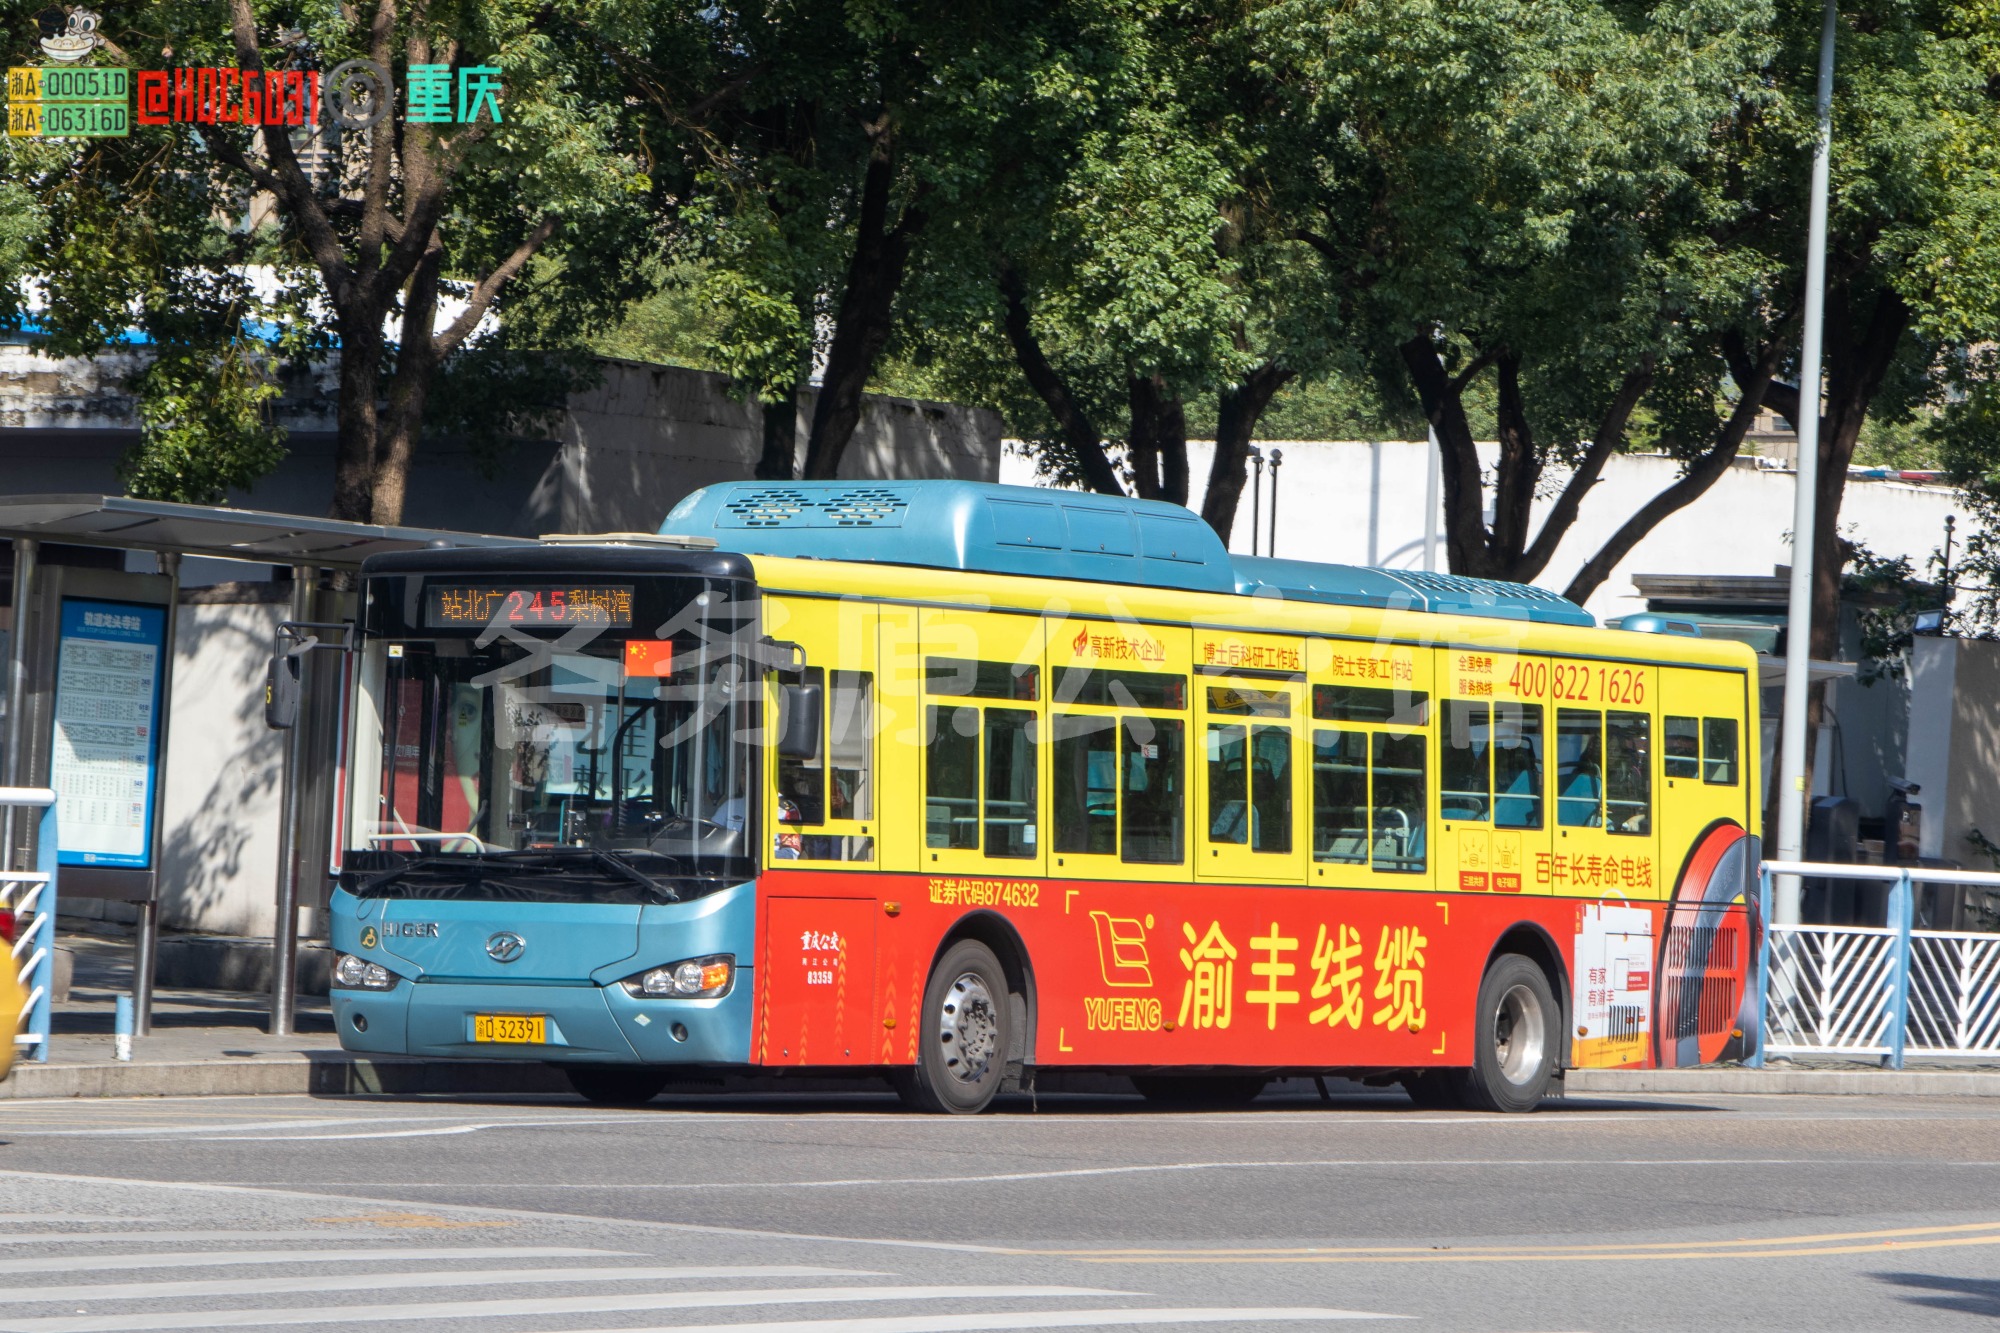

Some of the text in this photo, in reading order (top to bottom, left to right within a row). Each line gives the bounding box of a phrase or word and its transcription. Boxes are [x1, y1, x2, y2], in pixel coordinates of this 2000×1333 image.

[442, 589, 632, 622] 站北广 245 梨树湾
[1090, 635, 1166, 663] 高新技术企业
[1203, 642, 1300, 671] 博士后科研工作站
[1332, 654, 1413, 682] 院士专家工作站
[1458, 655, 1493, 674] 全国免费
[1458, 679, 1493, 697] 服务热线
[1509, 661, 1645, 705] 400 822 1626
[1535, 852, 1652, 888] 百年长寿命电线
[928, 878, 1039, 907] 证券代码874632
[381, 922, 440, 938] HIGER
[800, 930, 840, 951] 重庆公交
[807, 970, 833, 985] 83359
[1177, 920, 1428, 1032] 渝丰线缆
[1084, 997, 1162, 1032] YUFENG
